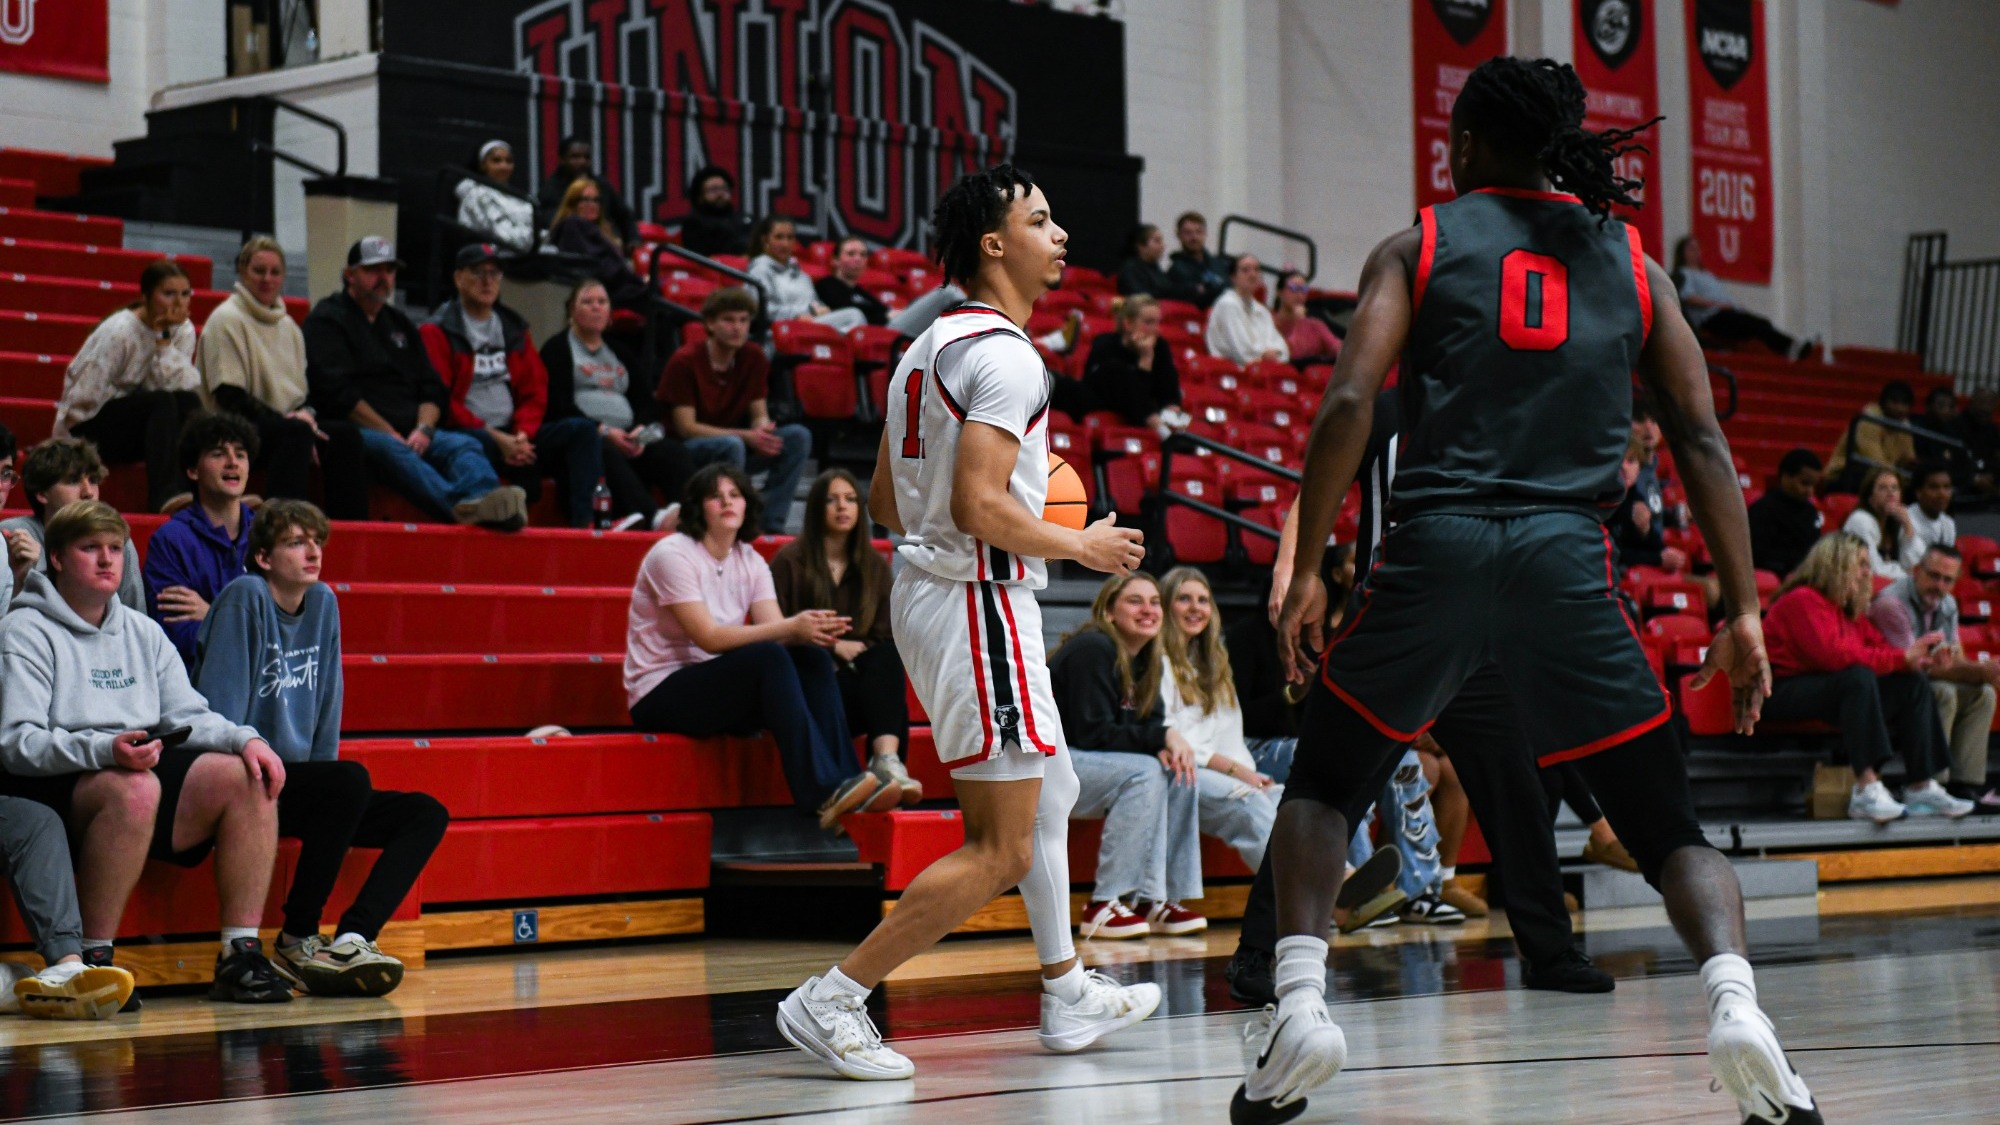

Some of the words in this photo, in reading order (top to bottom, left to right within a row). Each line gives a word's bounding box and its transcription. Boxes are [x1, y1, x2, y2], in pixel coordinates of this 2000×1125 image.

[514, 0, 1017, 252] UNION
[1700, 168, 1756, 222] 2016
[1718, 226, 1741, 263] U
[1498, 247, 1570, 352] 0
[901, 367, 926, 460] 1
